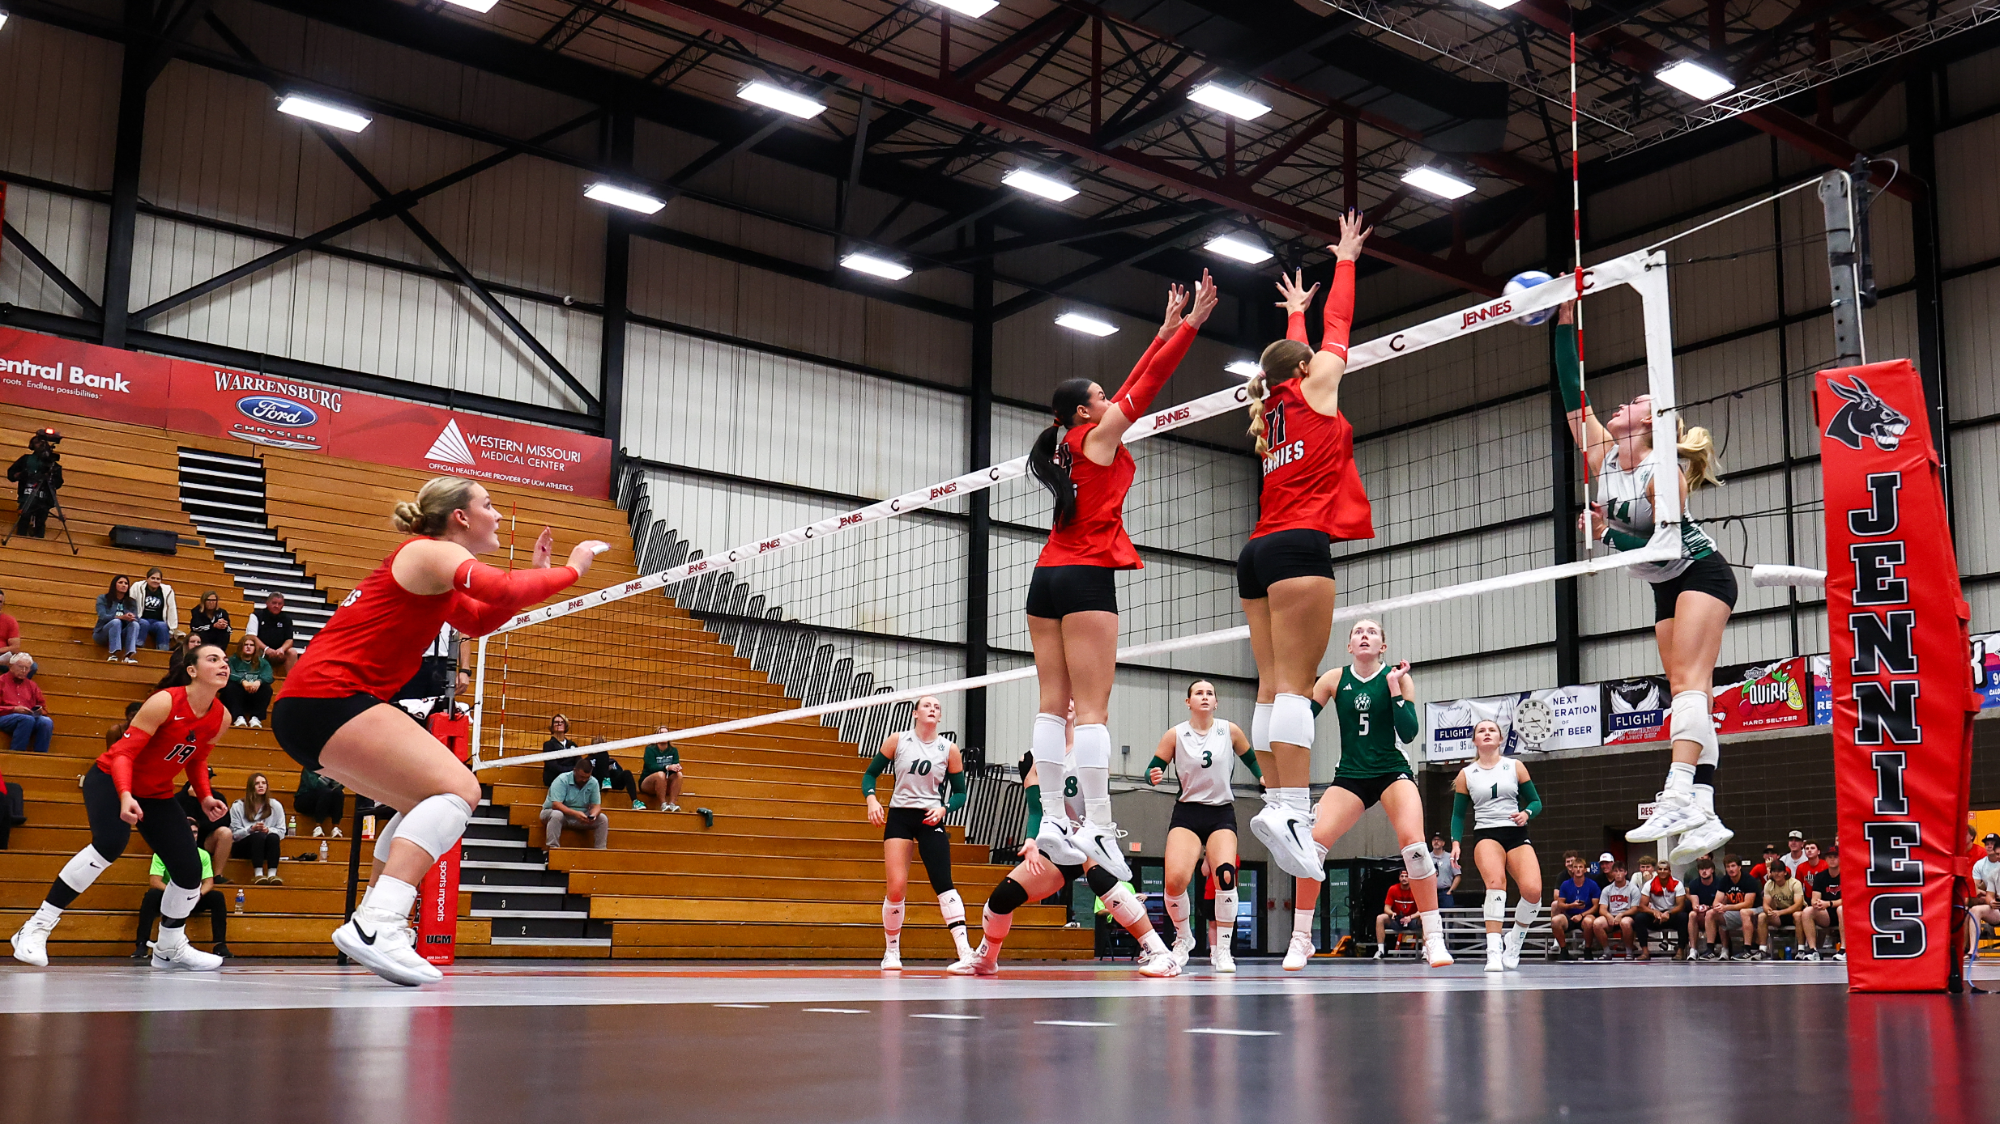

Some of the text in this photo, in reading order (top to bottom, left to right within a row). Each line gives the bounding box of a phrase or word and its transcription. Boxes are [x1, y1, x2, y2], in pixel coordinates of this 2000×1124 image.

[1460, 300, 1512, 330] JENNIES
[1389, 334, 1405, 352] C
[0, 358, 131, 393] entral Bank
[27, 380, 55, 392] Endless
[214, 371, 342, 413] WARRENSBURG
[253, 400, 300, 424] Ford
[1153, 407, 1190, 430] JENNIES
[233, 423, 317, 442] CHRYSLER
[1265, 400, 1287, 452] 11
[467, 433, 581, 463] WESTERN MISSOURI
[481, 451, 565, 472] MEDICAL CENTER
[1263, 439, 1304, 478] ENNIES
[428, 462, 574, 492] OFFICIAL HEALTHCARE PROVIDER OF UCM ATHLETICS
[929, 482, 957, 501] JENNIES
[1607, 497, 1631, 524] 14
[838, 512, 863, 529] JENNIES
[1553, 695, 1579, 706] NEXT
[1554, 705, 1597, 718] ERATION
[1616, 713, 1655, 727] FLIGHT
[1766, 715, 1798, 724] SELTZER
[1848, 471, 1927, 960] JENNIES
[1358, 713, 1370, 736] 5
[1439, 728, 1469, 739] FLIGHT
[1568, 725, 1592, 736] BEER
[164, 743, 197, 764] 19
[1201, 750, 1213, 768] 3
[908, 758, 932, 776] 10
[1064, 775, 1078, 798] 8
[1490, 782, 1498, 799] 1
[463, 852, 468, 861] 5
[481, 875, 486, 884] 4
[436, 860, 447, 922] sports imports
[501, 899, 506, 909] 3
[426, 934, 452, 944] UCM
[521, 926, 526, 935] 2
